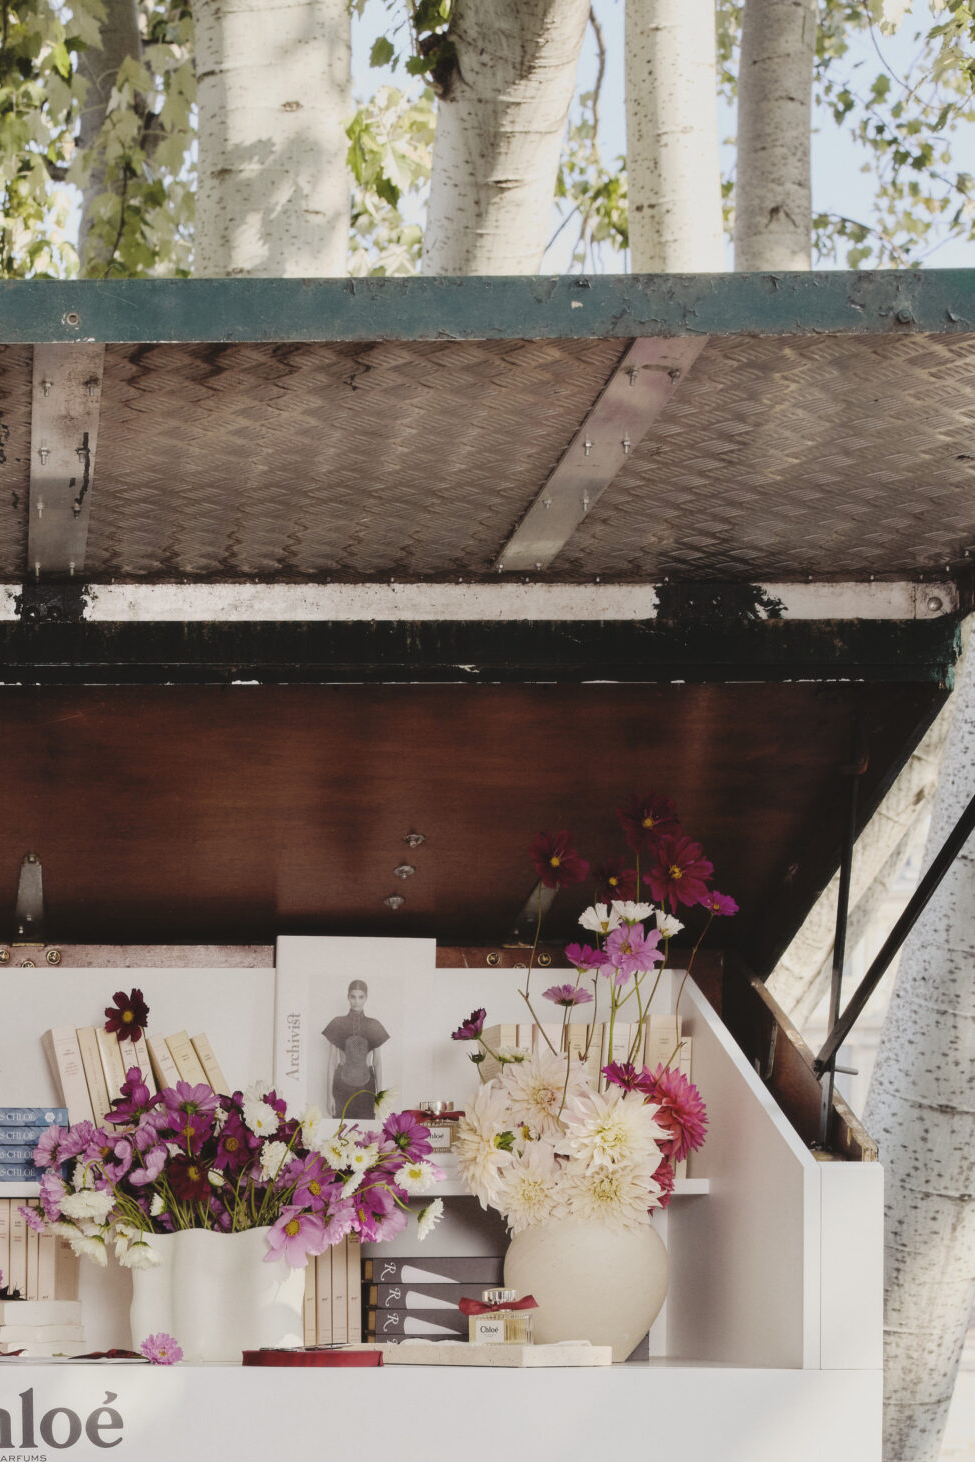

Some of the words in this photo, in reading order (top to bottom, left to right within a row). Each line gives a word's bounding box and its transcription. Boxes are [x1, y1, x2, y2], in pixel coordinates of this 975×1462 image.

[285, 1012, 301, 1081] Archivist
[429, 1132, 444, 1140] hloé
[480, 1325, 499, 1334] Chloé
